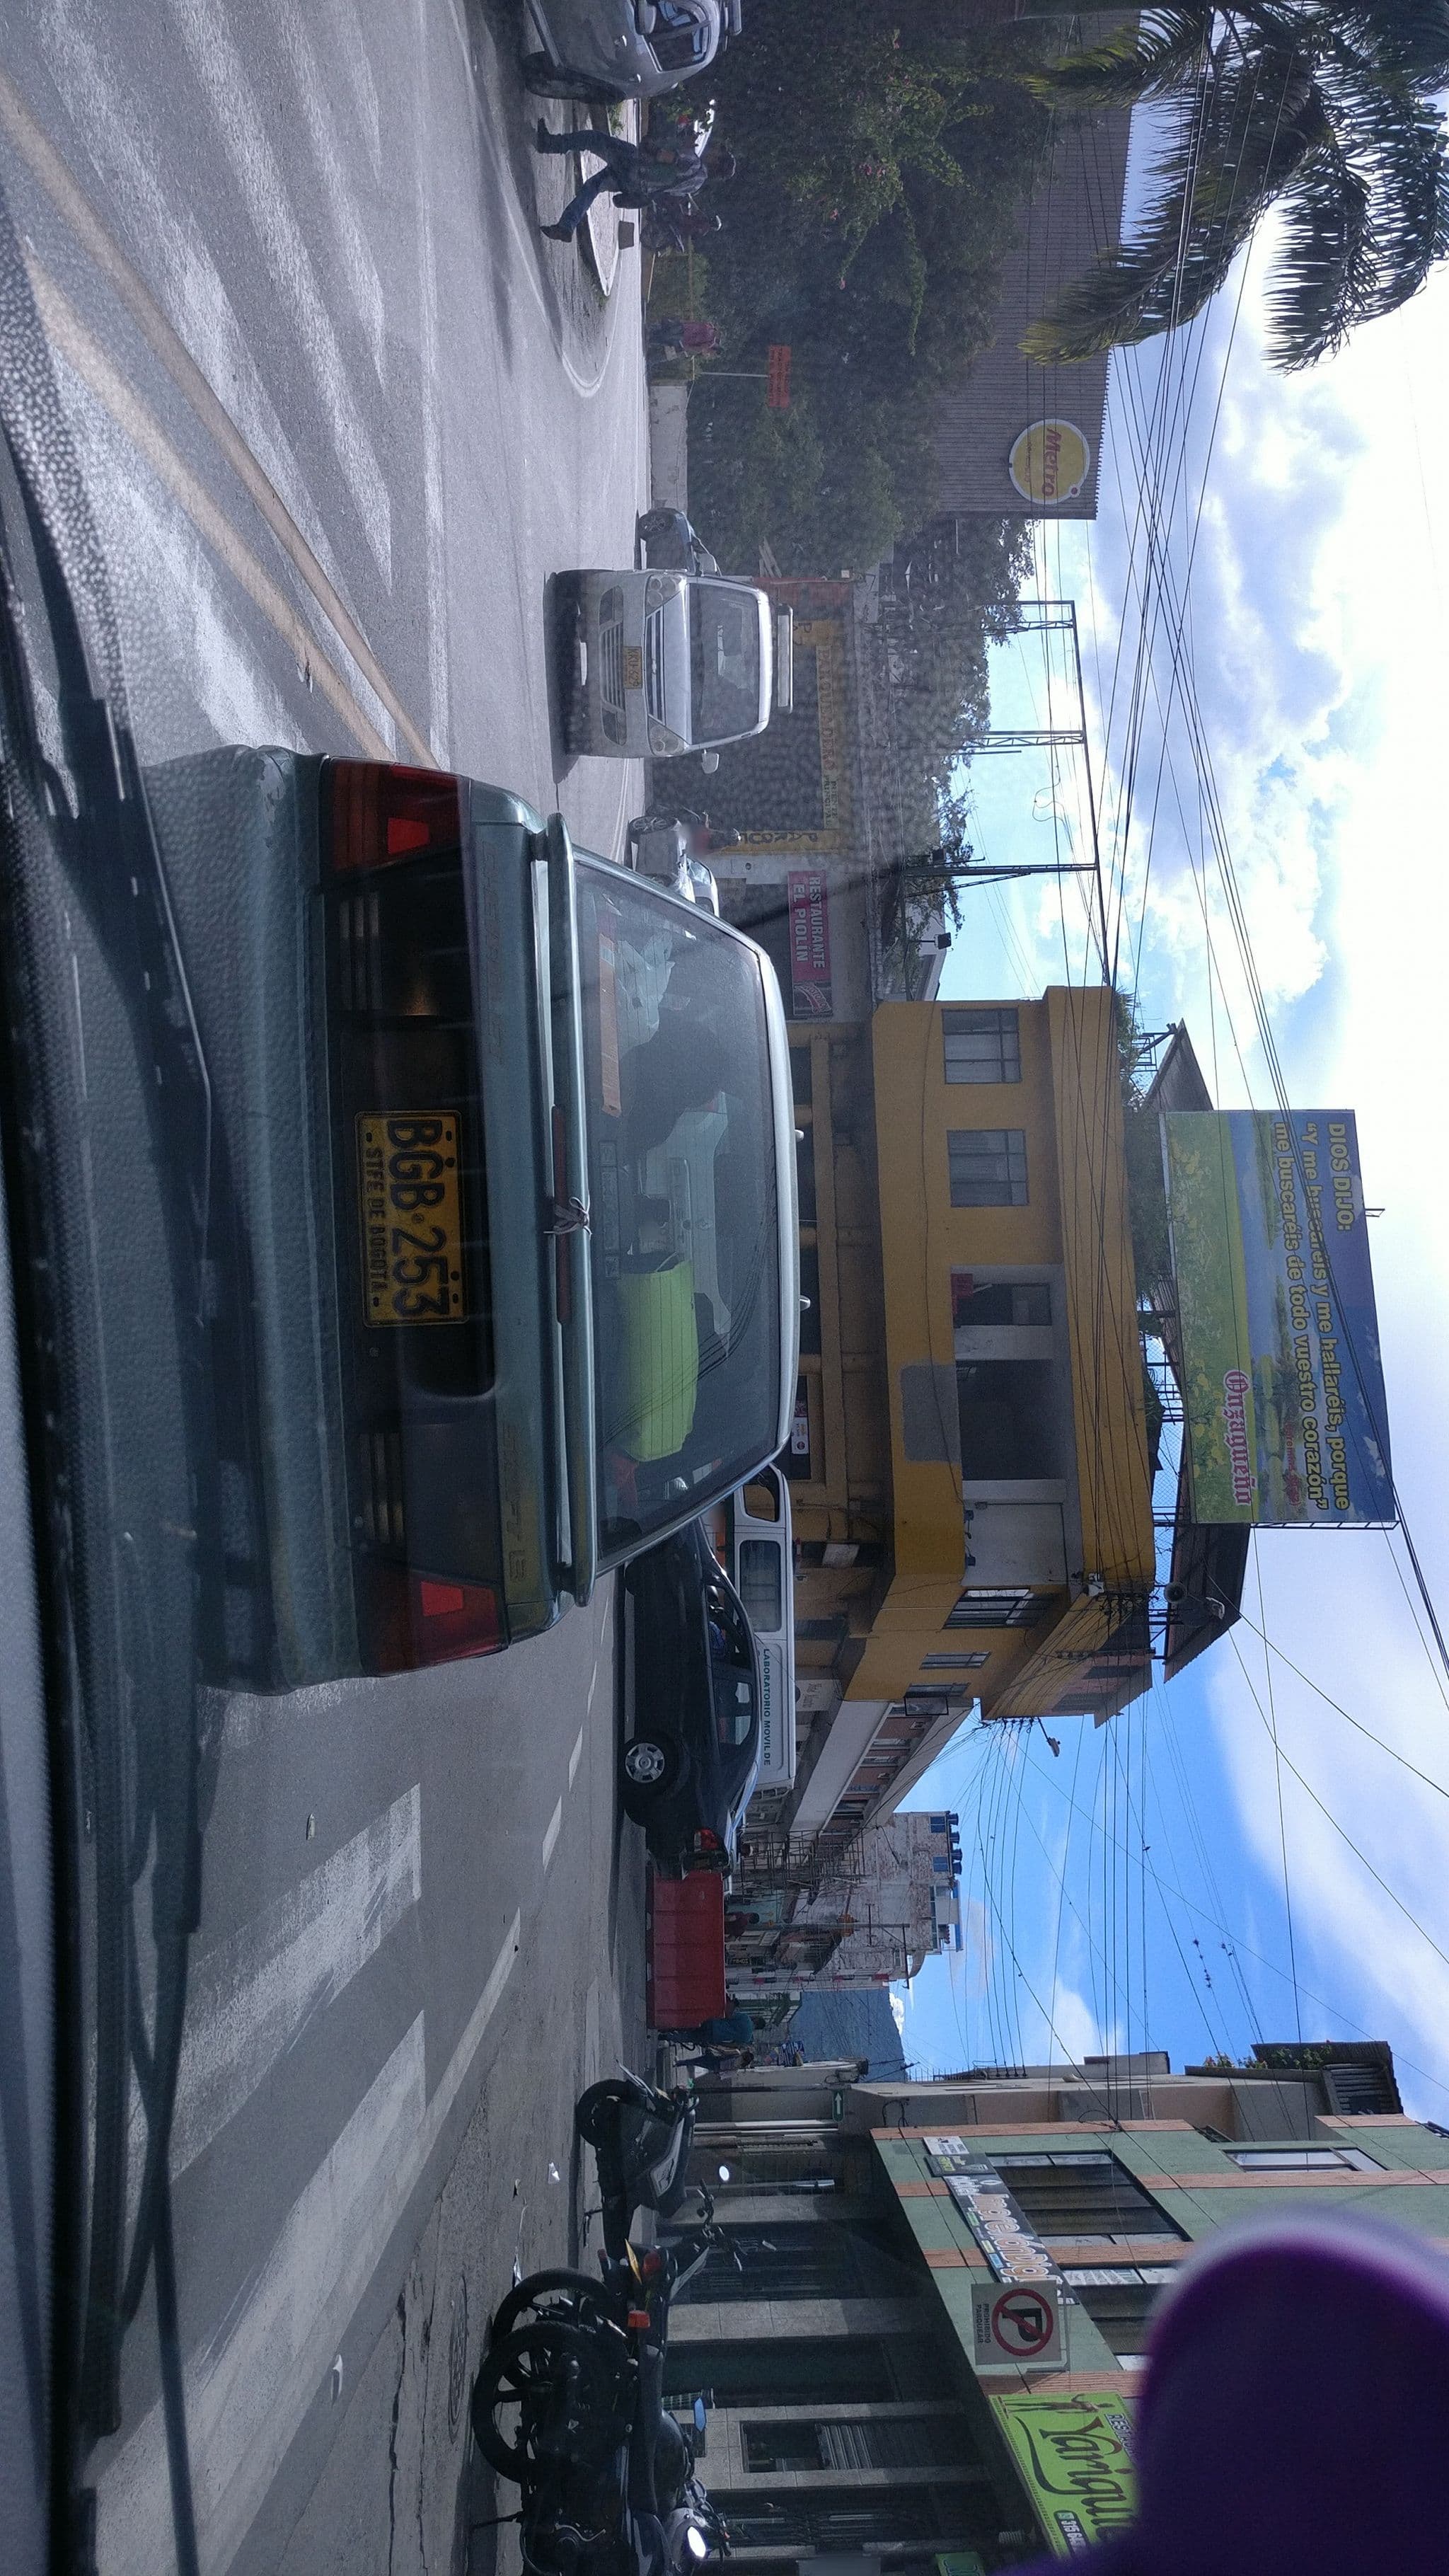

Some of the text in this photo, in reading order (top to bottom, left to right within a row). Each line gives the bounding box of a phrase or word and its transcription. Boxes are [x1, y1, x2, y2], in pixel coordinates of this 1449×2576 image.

[1041, 427, 1062, 497] Metro
[817, 649, 836, 771] PARQUEADERO
[792, 885, 810, 962] EL PIOLÍN
[809, 876, 825, 968] RESTAURANTE
[1274, 1122, 1290, 1151] me
[1303, 1151, 1318, 1180] me
[368, 1199, 386, 1219] DE
[1277, 1156, 1303, 1250] buscaréis
[1327, 1122, 1355, 1231] DIOS DIJO:
[1286, 1255, 1305, 1280] de
[1310, 1284, 1329, 1296] y
[1288, 1284, 1310, 1330] todo
[1316, 1301, 1333, 1333] me
[1294, 1335, 1318, 1413] vuestro
[1321, 1338, 1346, 1432] hallaréis,
[1224, 1371, 1256, 1505] Onzagueño
[1327, 1437, 1350, 1510] porque
[764, 1752, 770, 1766] DE
